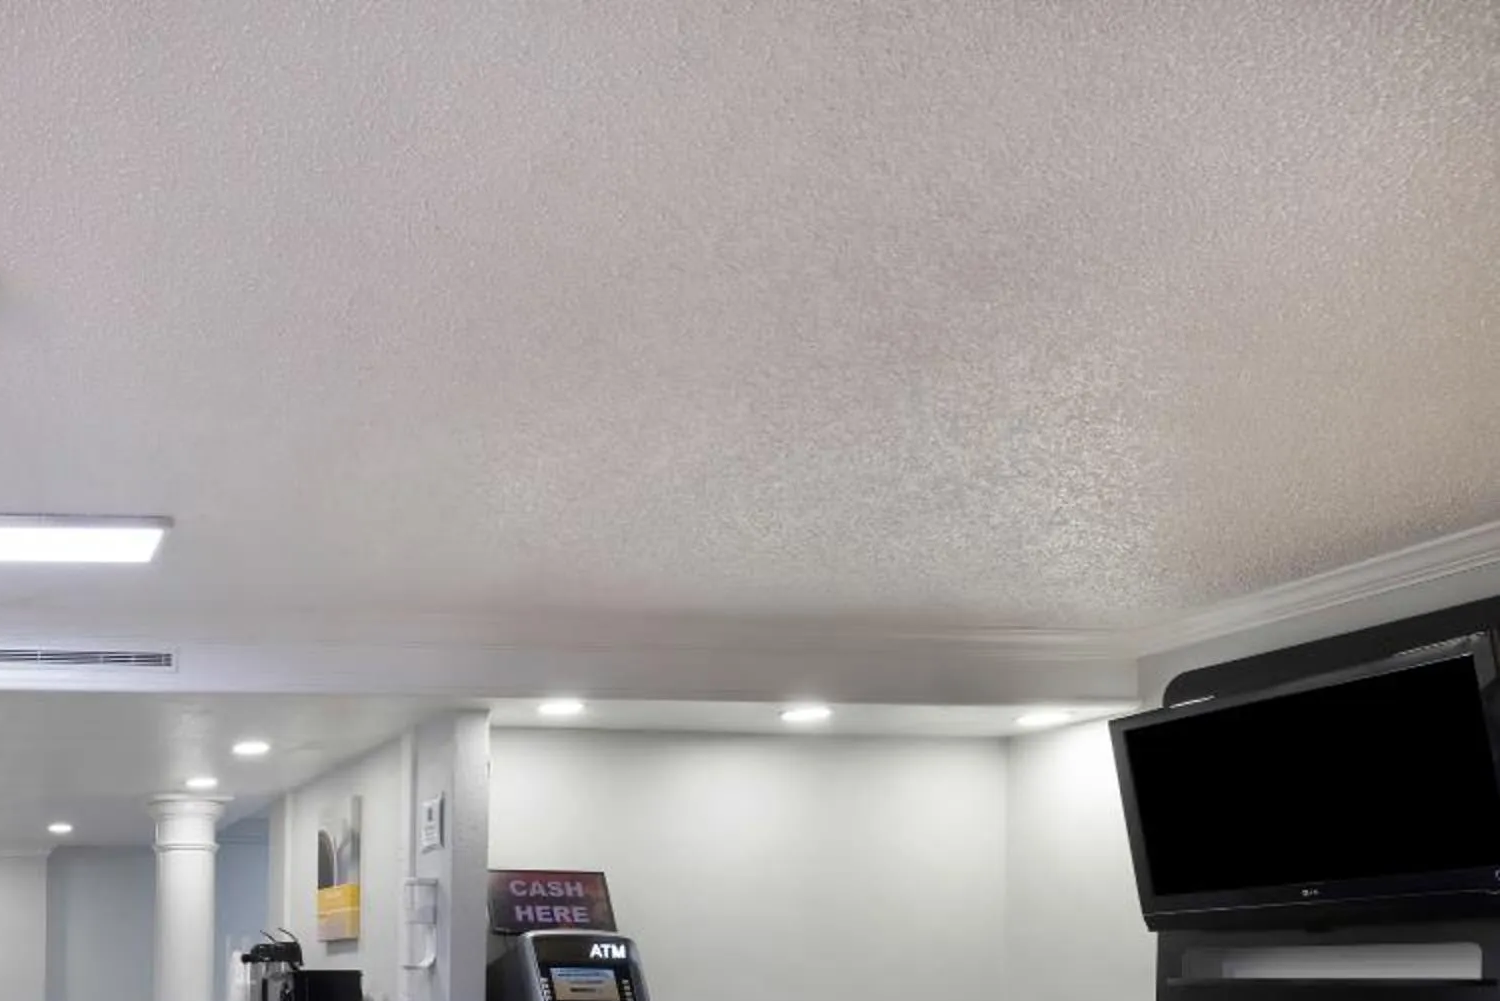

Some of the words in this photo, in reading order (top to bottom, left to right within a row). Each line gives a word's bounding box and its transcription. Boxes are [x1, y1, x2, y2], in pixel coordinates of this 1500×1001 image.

[508, 880, 585, 897] CASH
[514, 904, 590, 923] HERE
[588, 943, 627, 959] ATM
